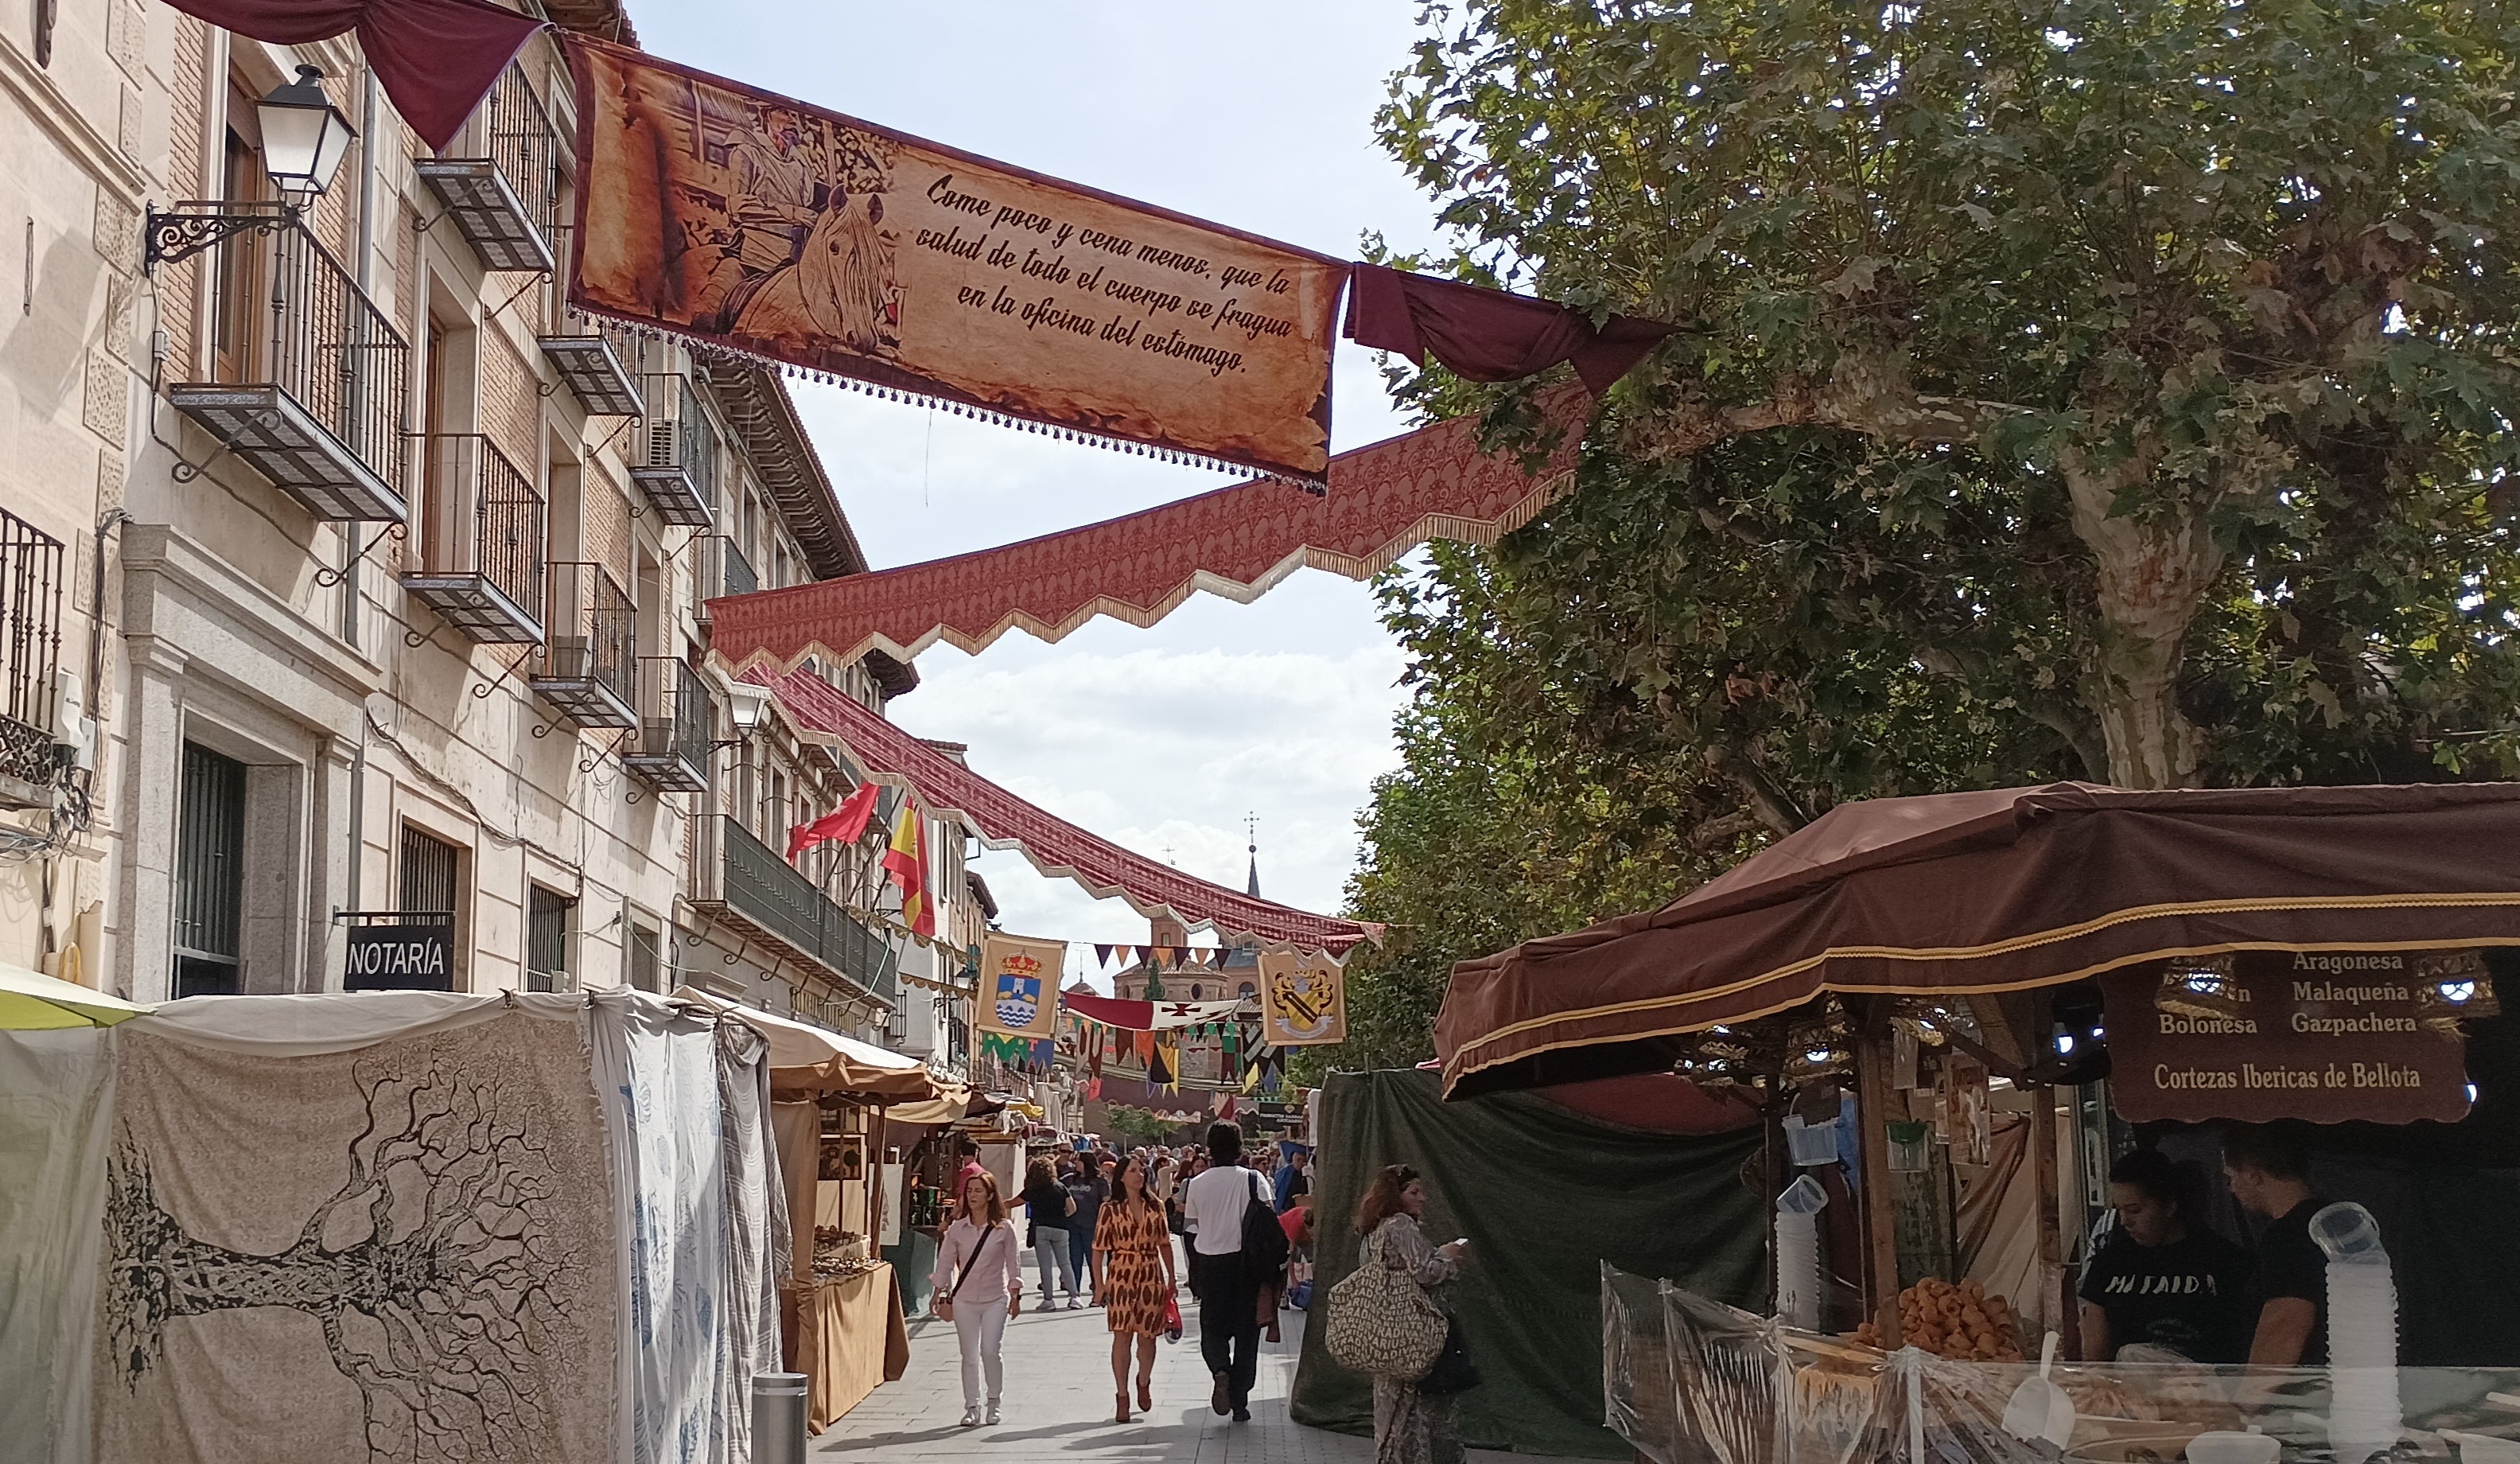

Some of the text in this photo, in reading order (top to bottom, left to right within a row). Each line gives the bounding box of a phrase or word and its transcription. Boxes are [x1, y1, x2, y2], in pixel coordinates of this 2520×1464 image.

[927, 173, 992, 216] Come
[990, 205, 1052, 234] poco
[1051, 223, 1074, 249] y
[1079, 228, 1133, 256] cena
[1220, 266, 1263, 290] que
[1266, 268, 1290, 294] la
[916, 226, 1292, 341] salud de todo el cuerpo se fragua
[957, 285, 1246, 378] en la oficina del estómago.
[348, 936, 445, 975] NOTARÍA
[2292, 951, 2404, 975] Aragonesa
[2292, 980, 2409, 1005] Malaqueña
[2291, 1011, 2417, 1037] Gazpachera
[2154, 1062, 2421, 1089] Cortezas Ibericas de Bellota
